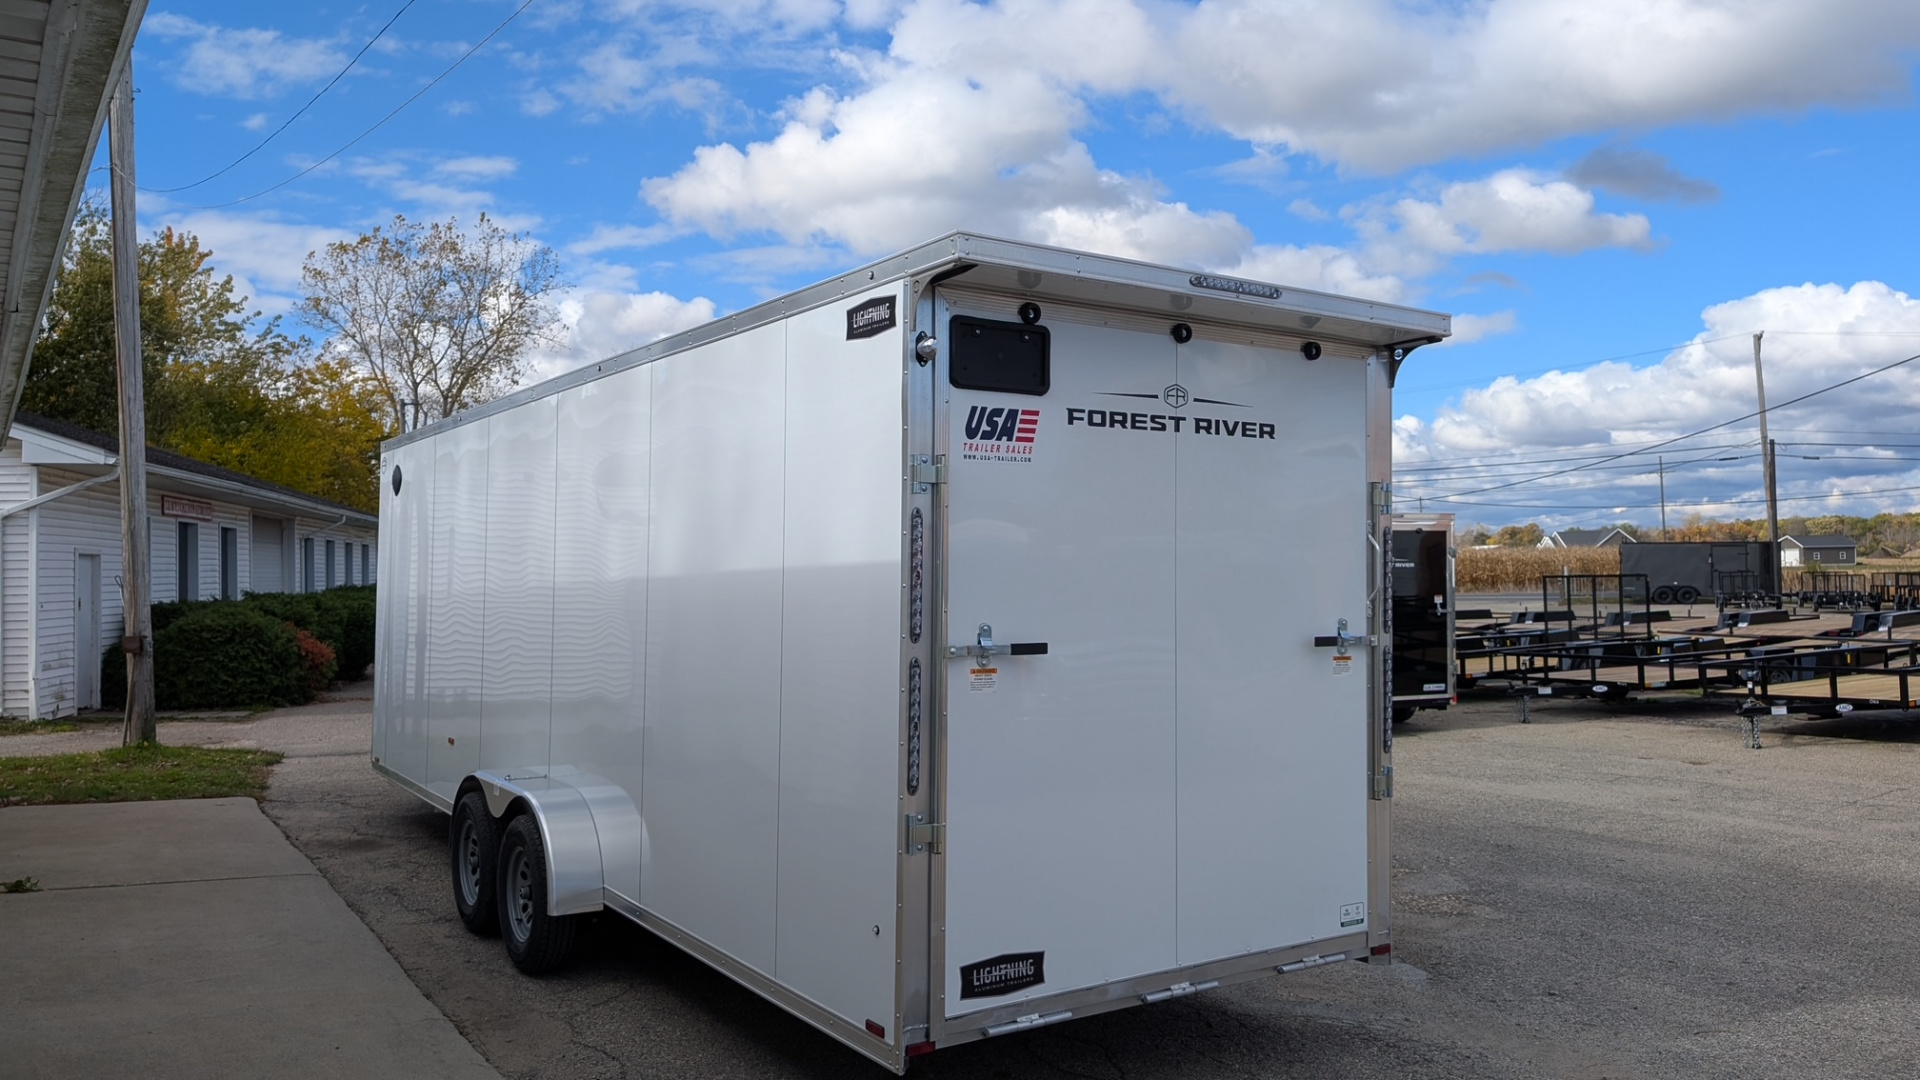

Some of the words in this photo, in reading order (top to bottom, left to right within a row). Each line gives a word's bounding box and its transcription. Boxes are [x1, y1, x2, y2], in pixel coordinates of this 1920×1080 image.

[853, 303, 890, 328] LIGHTNING
[965, 405, 1019, 442] USA
[1066, 408, 1187, 433] FOREST
[1193, 417, 1276, 440] RIVER
[963, 443, 1001, 453] TRAILER
[1005, 445, 1034, 455] SALES
[963, 454, 1032, 463] WWW.USA-TRAILER.COM
[973, 959, 1035, 986] LIGHTNING
[974, 983, 1005, 992] ALUMINUM
[1007, 977, 1034, 986] TRAILERS
